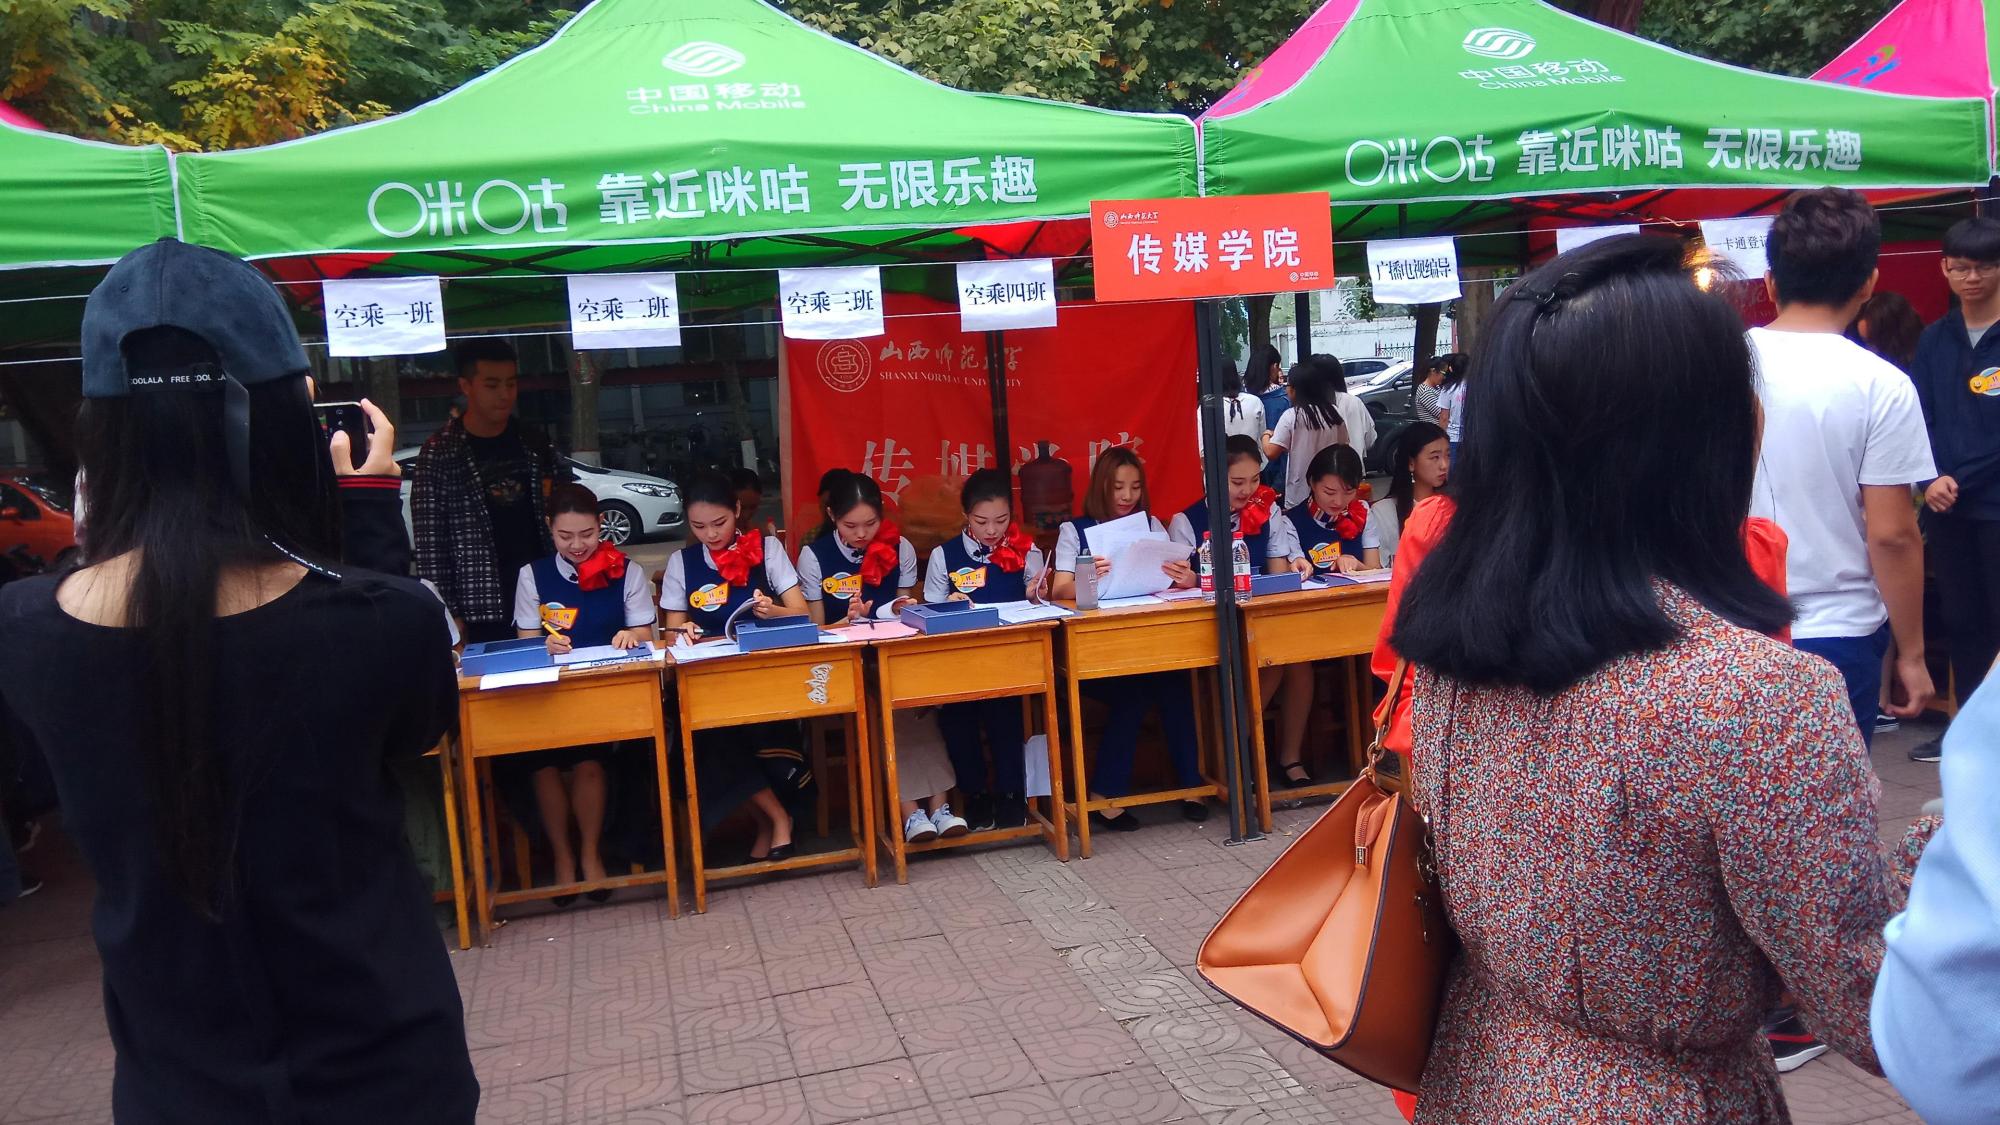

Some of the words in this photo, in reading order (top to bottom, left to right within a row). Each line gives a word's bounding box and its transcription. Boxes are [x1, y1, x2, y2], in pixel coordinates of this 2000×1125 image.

[1458, 59, 1609, 81] 中国移动
[626, 82, 801, 103] 中国移动
[1478, 79, 1548, 91] China
[1548, 74, 1626, 87] Mobile
[628, 102, 710, 115] China
[716, 99, 807, 111] Mobile
[1516, 124, 1683, 176] 靠近咪咕
[1703, 127, 1863, 172] 无限乐趣
[596, 163, 811, 225] 靠近咪咕
[838, 154, 1038, 212] 无限乐趣
[1127, 227, 1300, 276] 传媒学院
[1376, 257, 1452, 281] 广播电视编导
[964, 281, 1047, 306] 空乘四班
[334, 301, 435, 329] 空乘一班
[577, 296, 671, 323] 空乘二班
[879, 340, 1024, 372] 山西师范学
[170, 375, 191, 383] FREE
[879, 371, 919, 381] SHANXI
